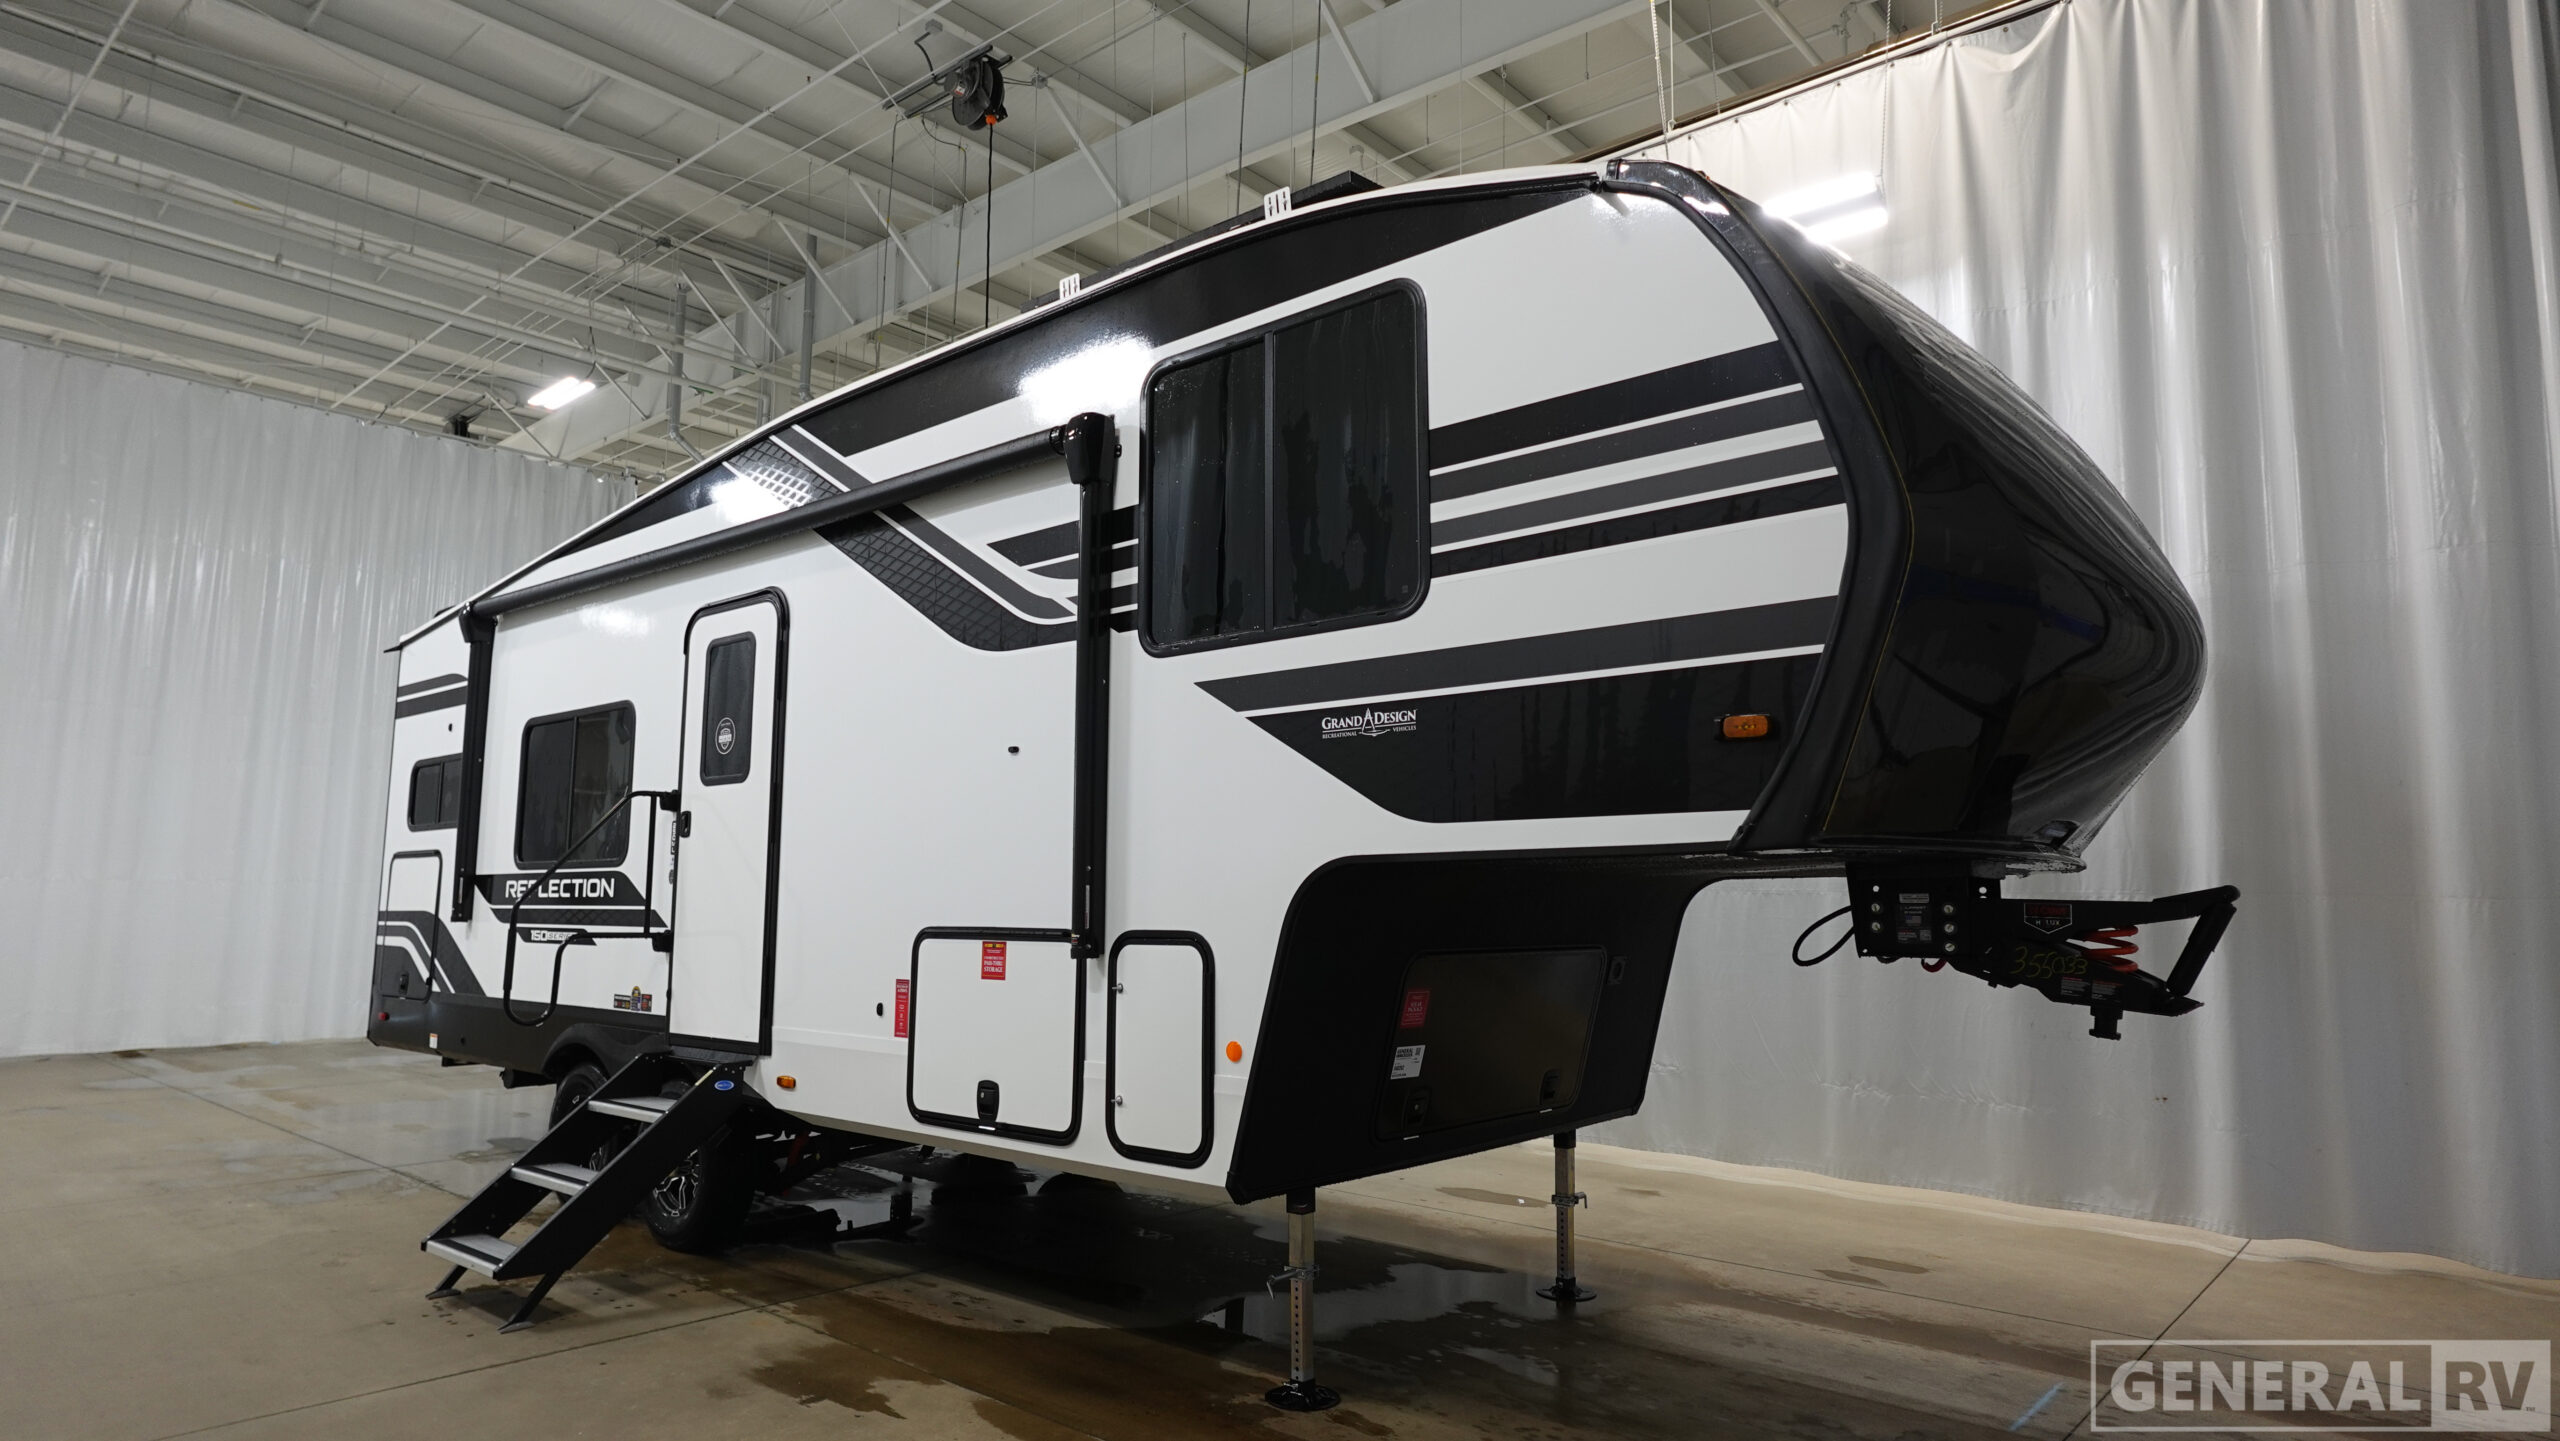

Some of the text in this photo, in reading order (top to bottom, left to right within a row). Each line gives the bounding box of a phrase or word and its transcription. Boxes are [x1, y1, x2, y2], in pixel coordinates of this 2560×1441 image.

[1322, 710, 1416, 729] GRAND DESIGN
[1322, 731, 1358, 739] RECREATIONAL
[530, 929, 548, 942] 150
[2009, 945, 2089, 979] 355033
